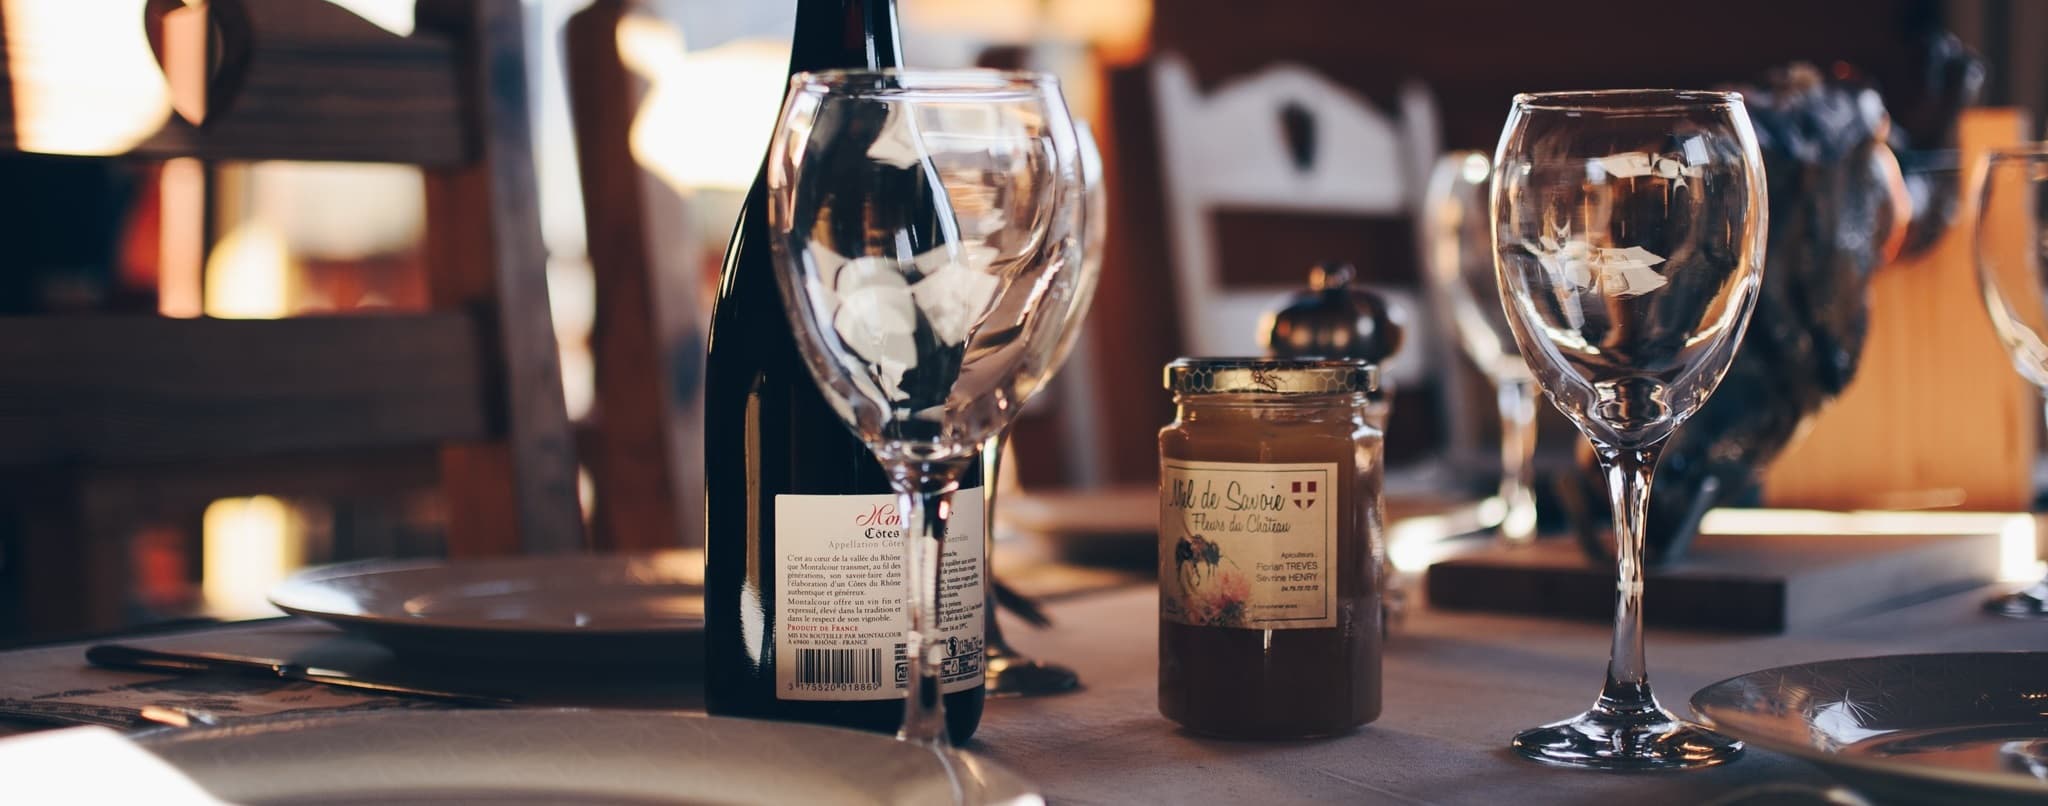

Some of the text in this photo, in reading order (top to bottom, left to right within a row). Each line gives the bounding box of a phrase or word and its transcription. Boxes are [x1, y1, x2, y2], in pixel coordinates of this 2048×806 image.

[1201, 479, 1219, 510] de
[1224, 480, 1285, 511] Savoie
[1192, 513, 1225, 532] Fleurs
[1228, 515, 1244, 532] du
[864, 527, 900, 539] Côtes
[828, 540, 879, 550] Appellation
[787, 598, 830, 606] Montalcour
[787, 607, 819, 615] expressif,
[812, 616, 836, 624] respect
